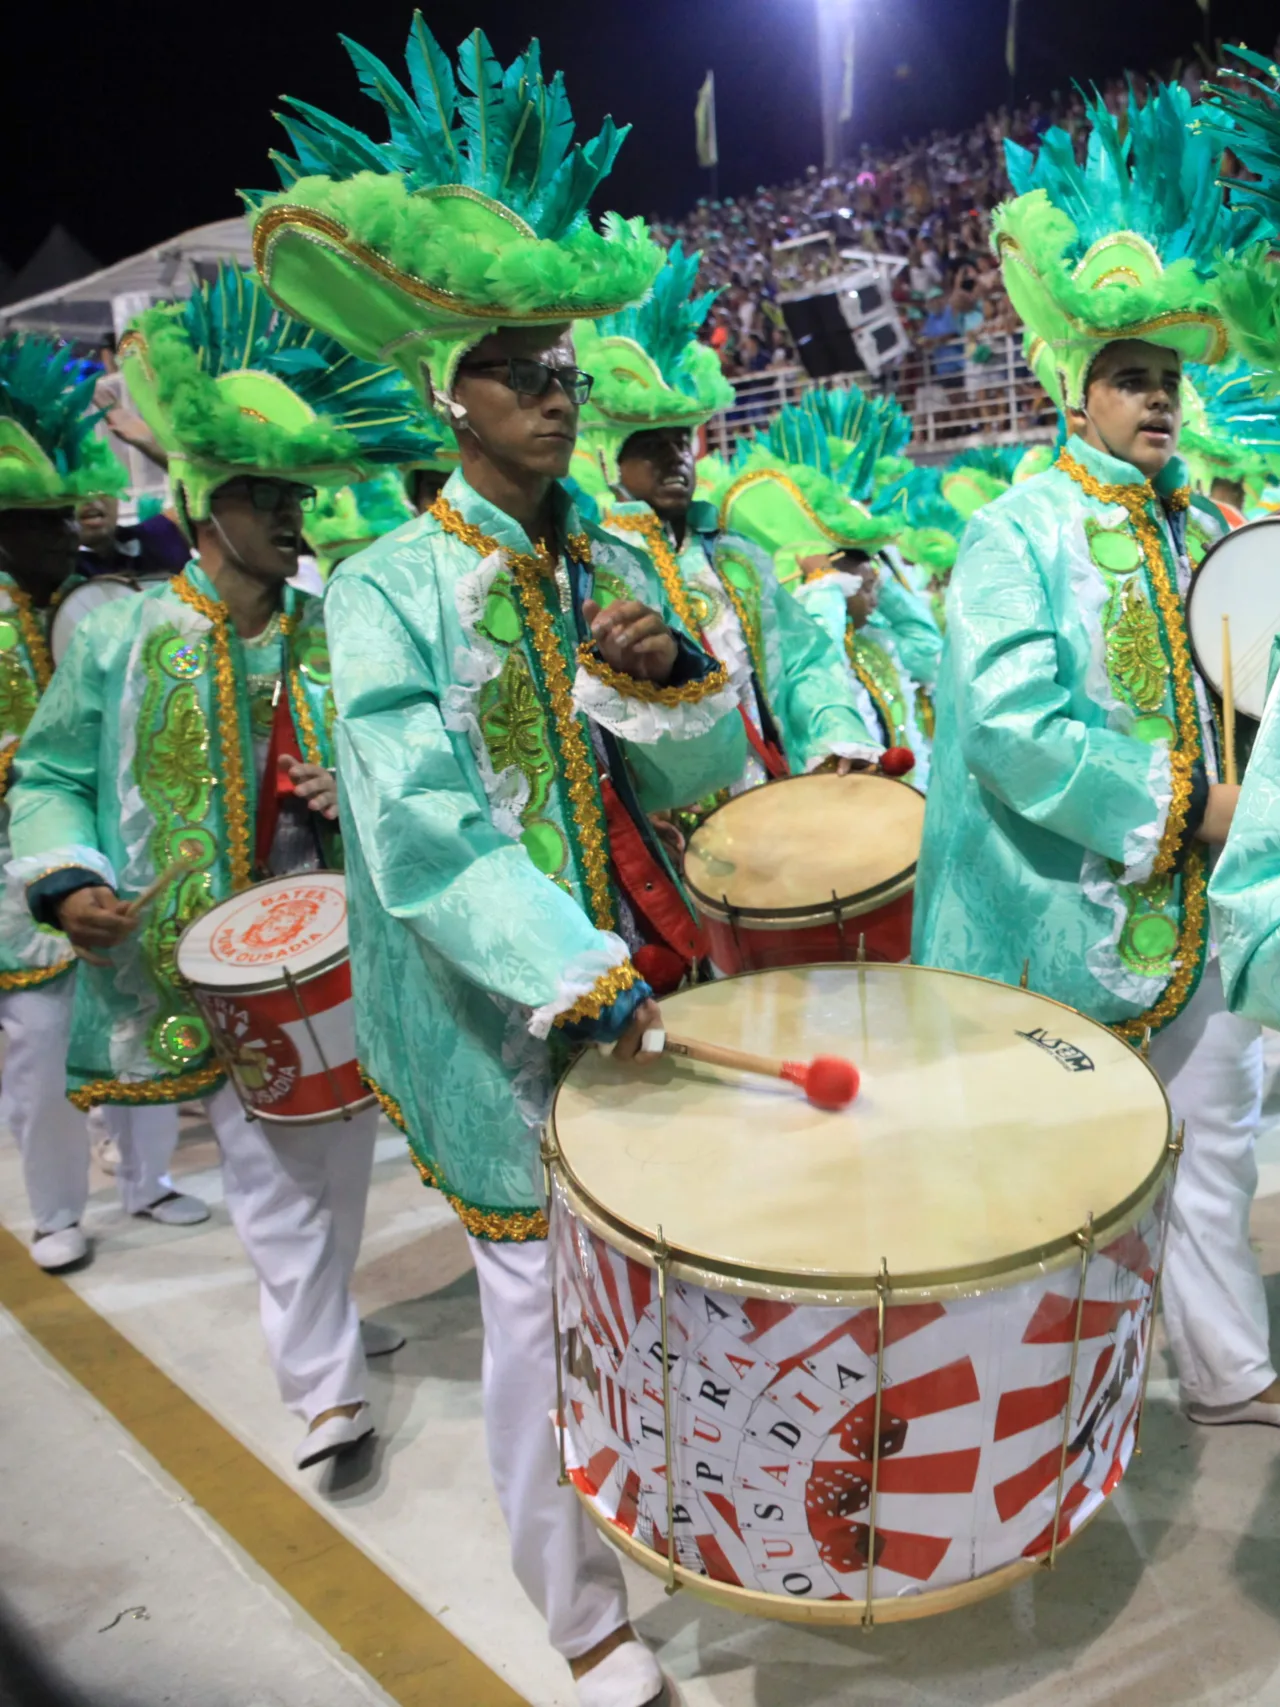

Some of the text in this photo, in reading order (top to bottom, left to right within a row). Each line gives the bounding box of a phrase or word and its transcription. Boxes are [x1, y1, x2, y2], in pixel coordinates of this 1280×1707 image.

[235, 932, 323, 963] OUSADIA
[692, 1351, 756, 1486] PURA
[753, 1363, 864, 1596] OUSADIA
